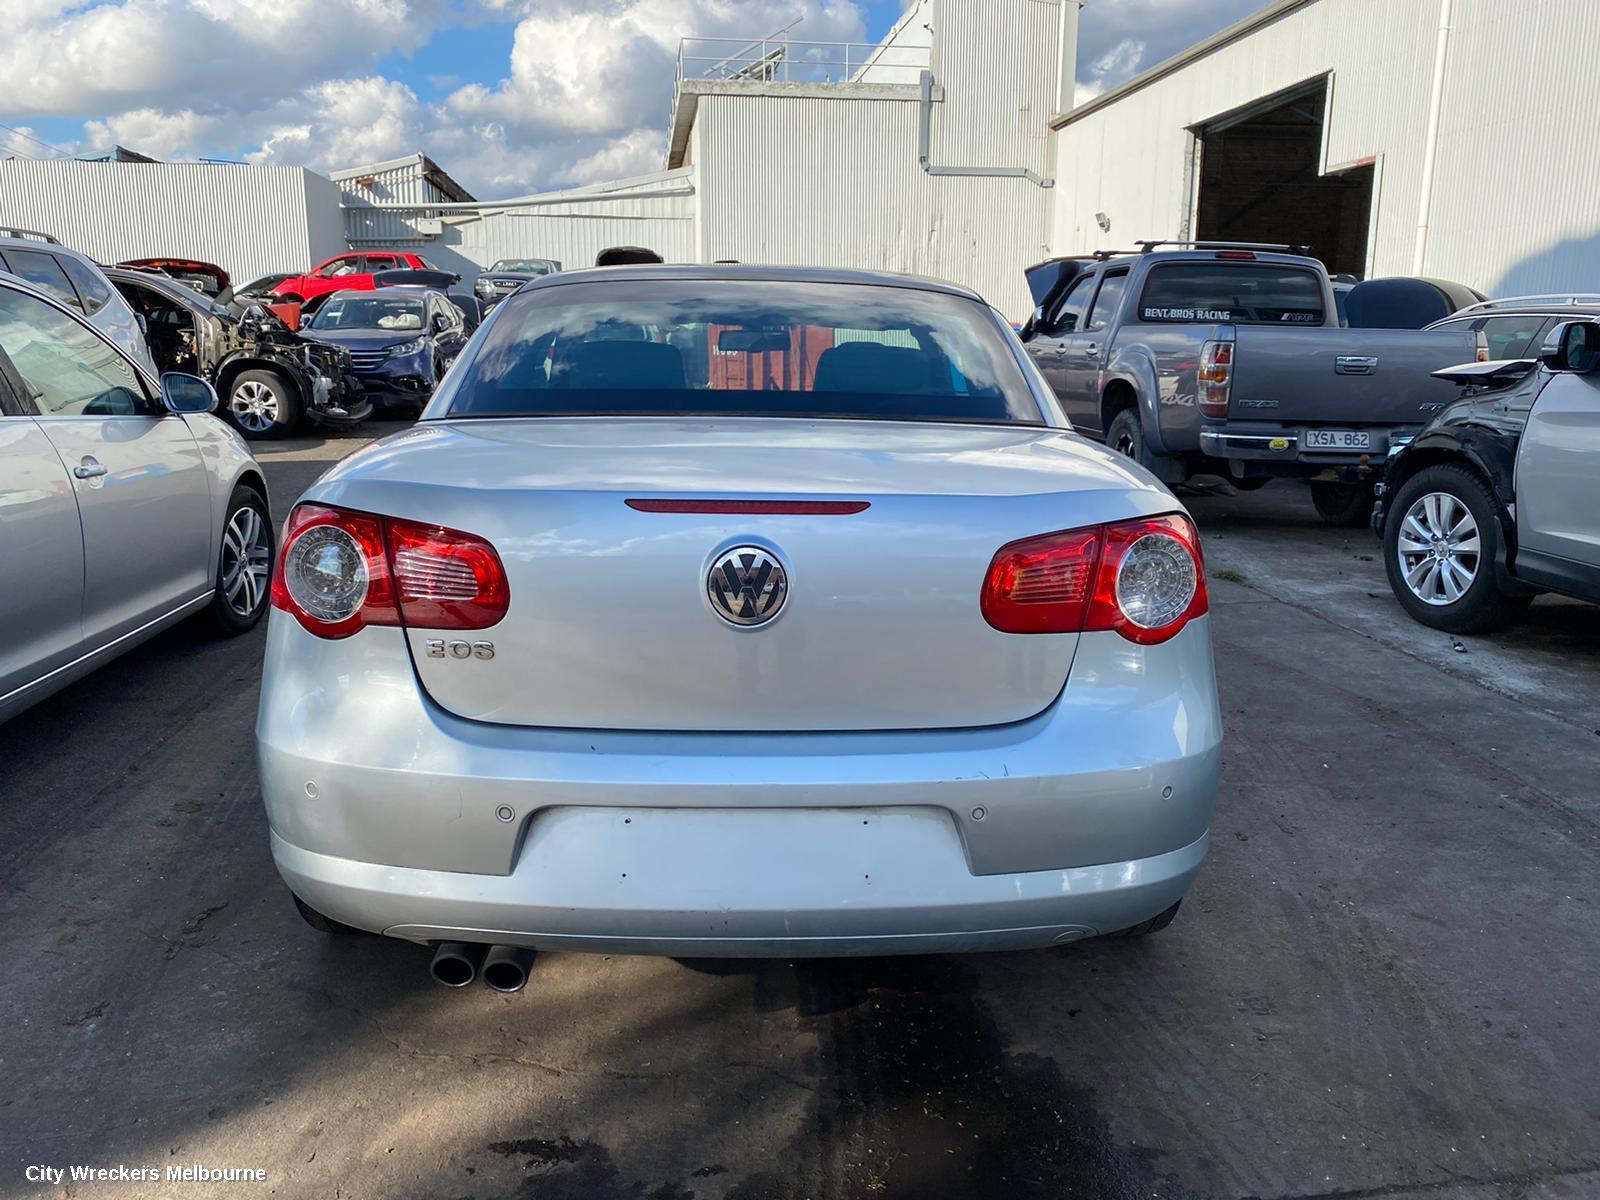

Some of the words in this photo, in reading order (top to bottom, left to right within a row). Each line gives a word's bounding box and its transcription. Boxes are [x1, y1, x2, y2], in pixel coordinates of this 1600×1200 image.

[1145, 308, 1168, 318] BENT
[1171, 309, 1194, 319] BROS
[1197, 311, 1230, 320] RACING
[426, 639, 495, 660] EOS
